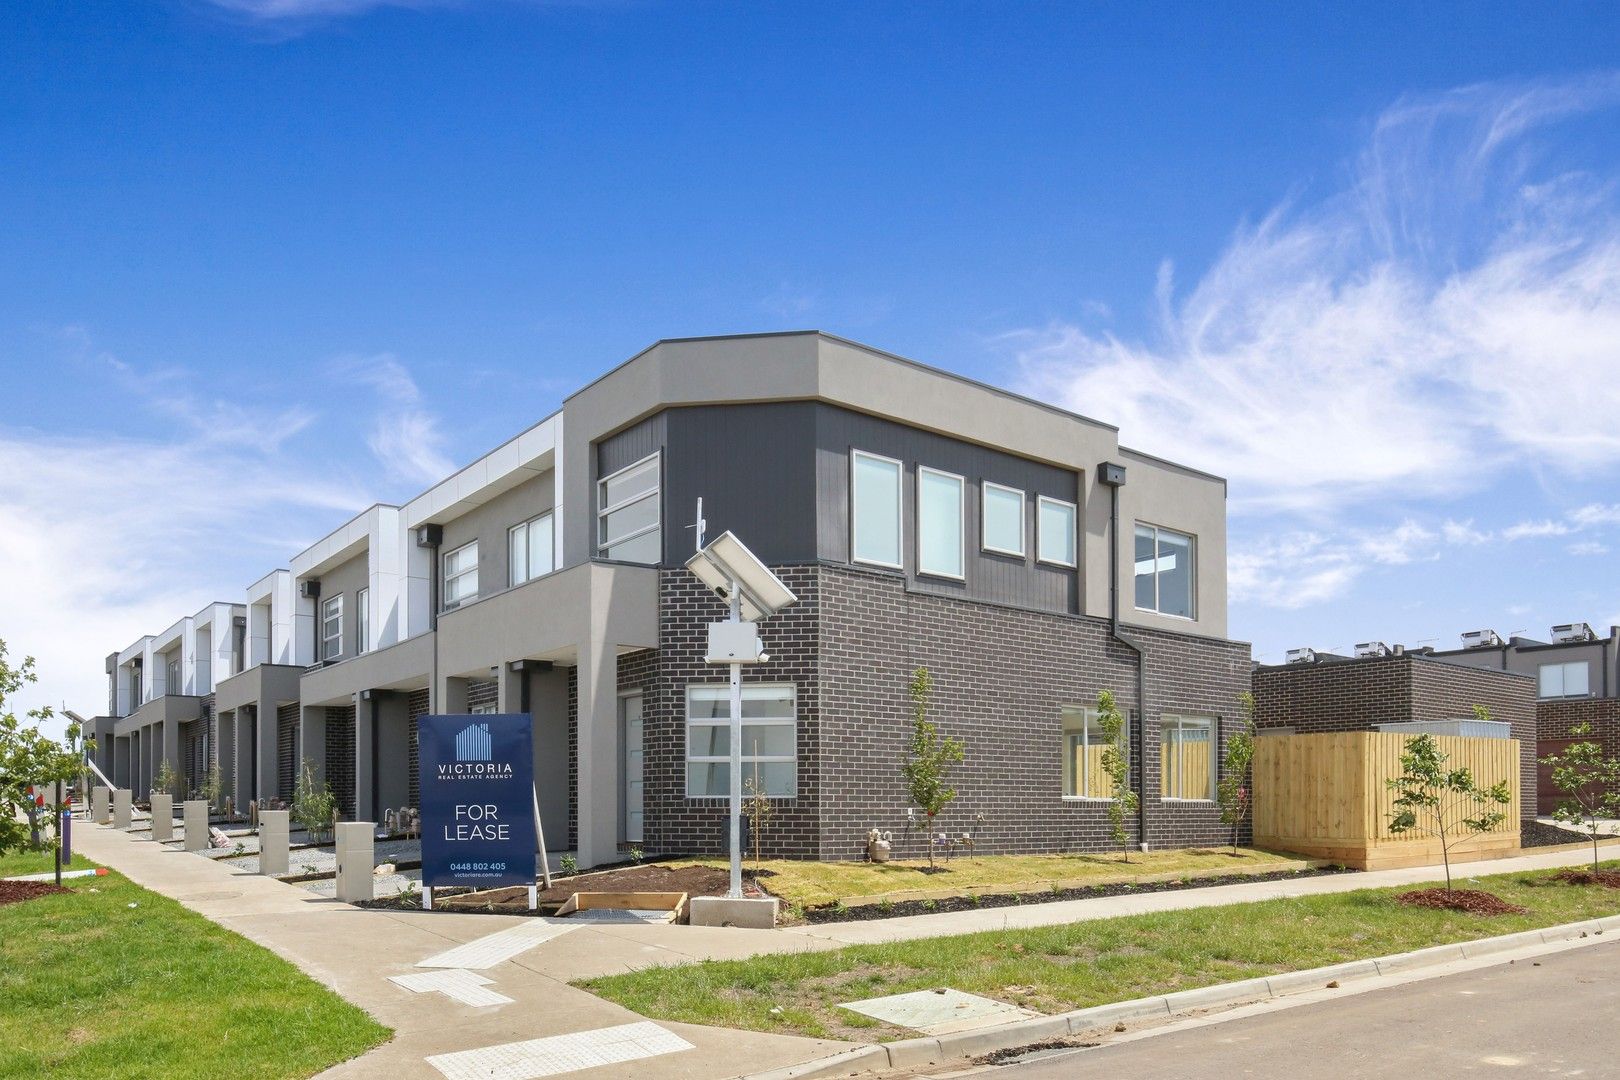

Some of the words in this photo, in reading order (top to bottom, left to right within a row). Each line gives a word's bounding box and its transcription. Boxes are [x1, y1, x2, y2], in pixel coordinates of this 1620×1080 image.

[438, 763, 513, 774] VICTORIA
[455, 804, 498, 820] FOR
[444, 824, 510, 840] LEASE
[450, 862, 471, 870] 0448
[472, 862, 489, 870] 802
[489, 862, 506, 870] 405
